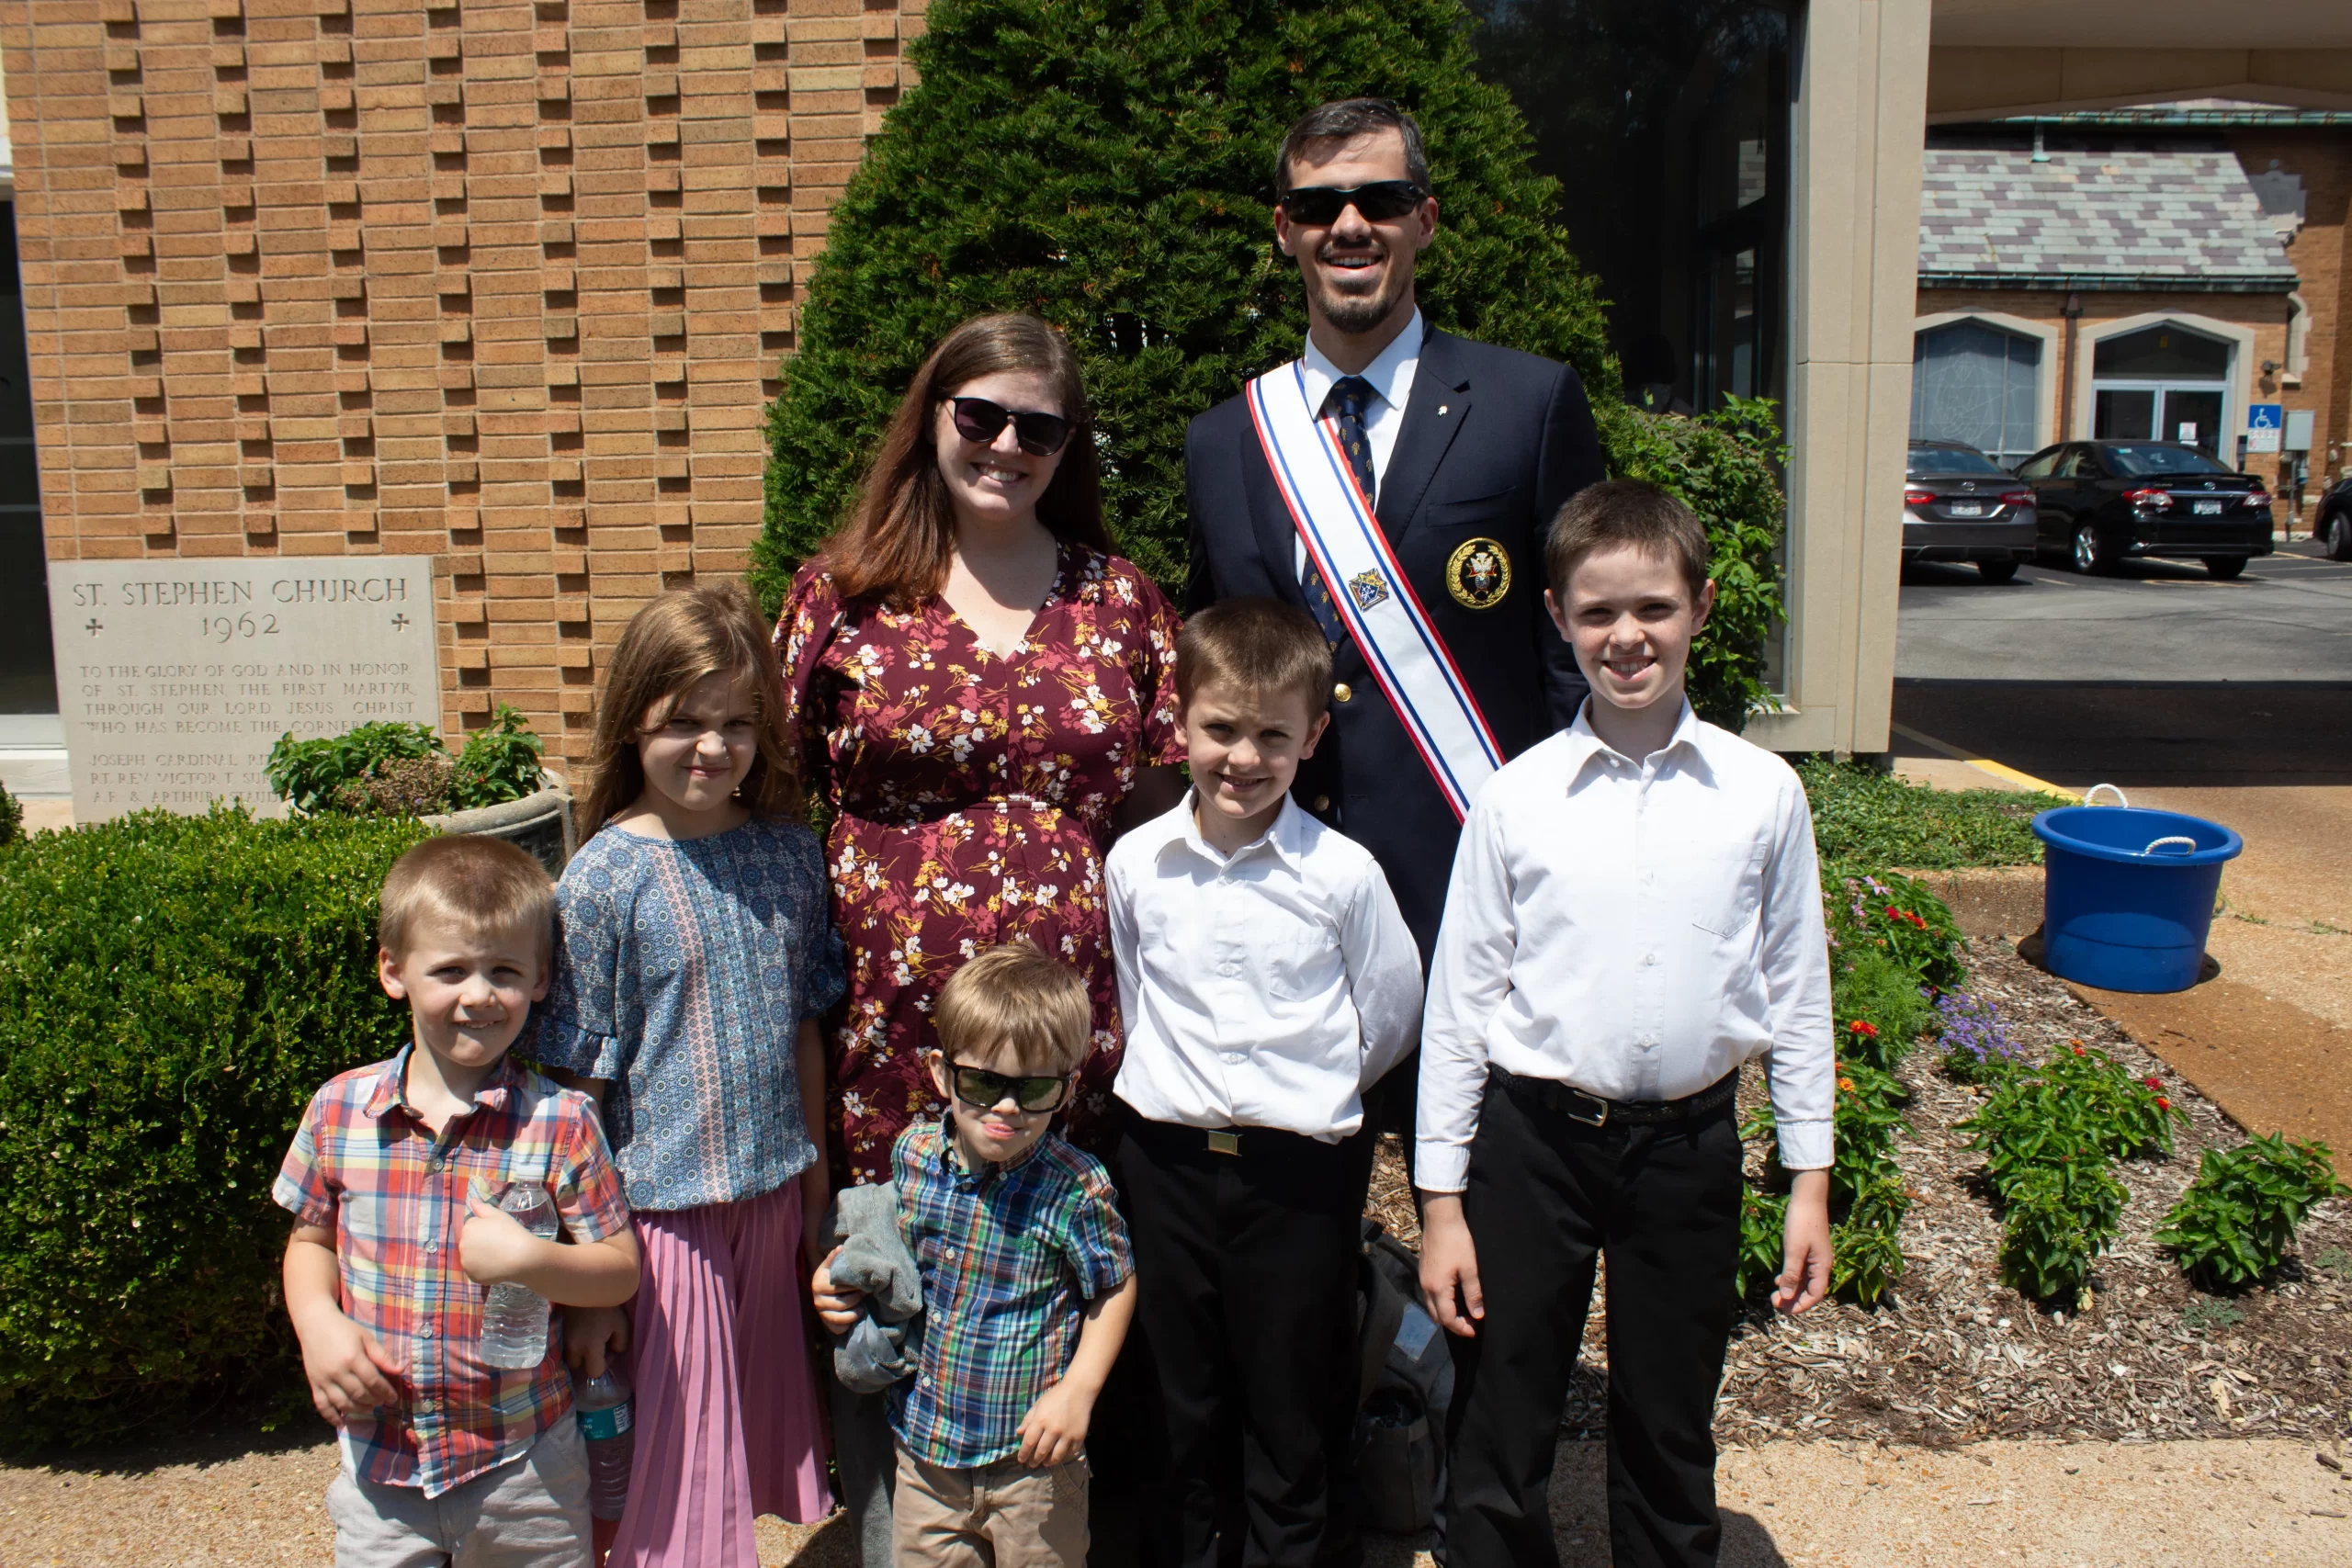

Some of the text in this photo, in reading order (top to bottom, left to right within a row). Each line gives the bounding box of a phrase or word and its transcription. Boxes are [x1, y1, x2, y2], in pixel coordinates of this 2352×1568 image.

[73, 579, 406, 606] ST. STEPHEN CHURCH
[202, 612, 279, 643] 1962
[79, 663, 411, 678] TO THE GLORY OF GOD AND IN HONOR
[82, 685, 102, 696] OF
[118, 684, 138, 696] ST.
[238, 684, 271, 695] THE
[283, 683, 326, 695] FIRST
[85, 702, 414, 715] THROUGH OUR LORD JESUS CHRIST
[136, 722, 166, 733] HAS
[176, 721, 243, 733] BECOME
[250, 721, 281, 732] THE
[89, 755, 145, 766] JOSEPH
[155, 754, 237, 766] CARDINAL
[157, 773, 219, 784] VICTOR
[130, 792, 141, 802] &
[152, 791, 213, 803] ARTHUR
